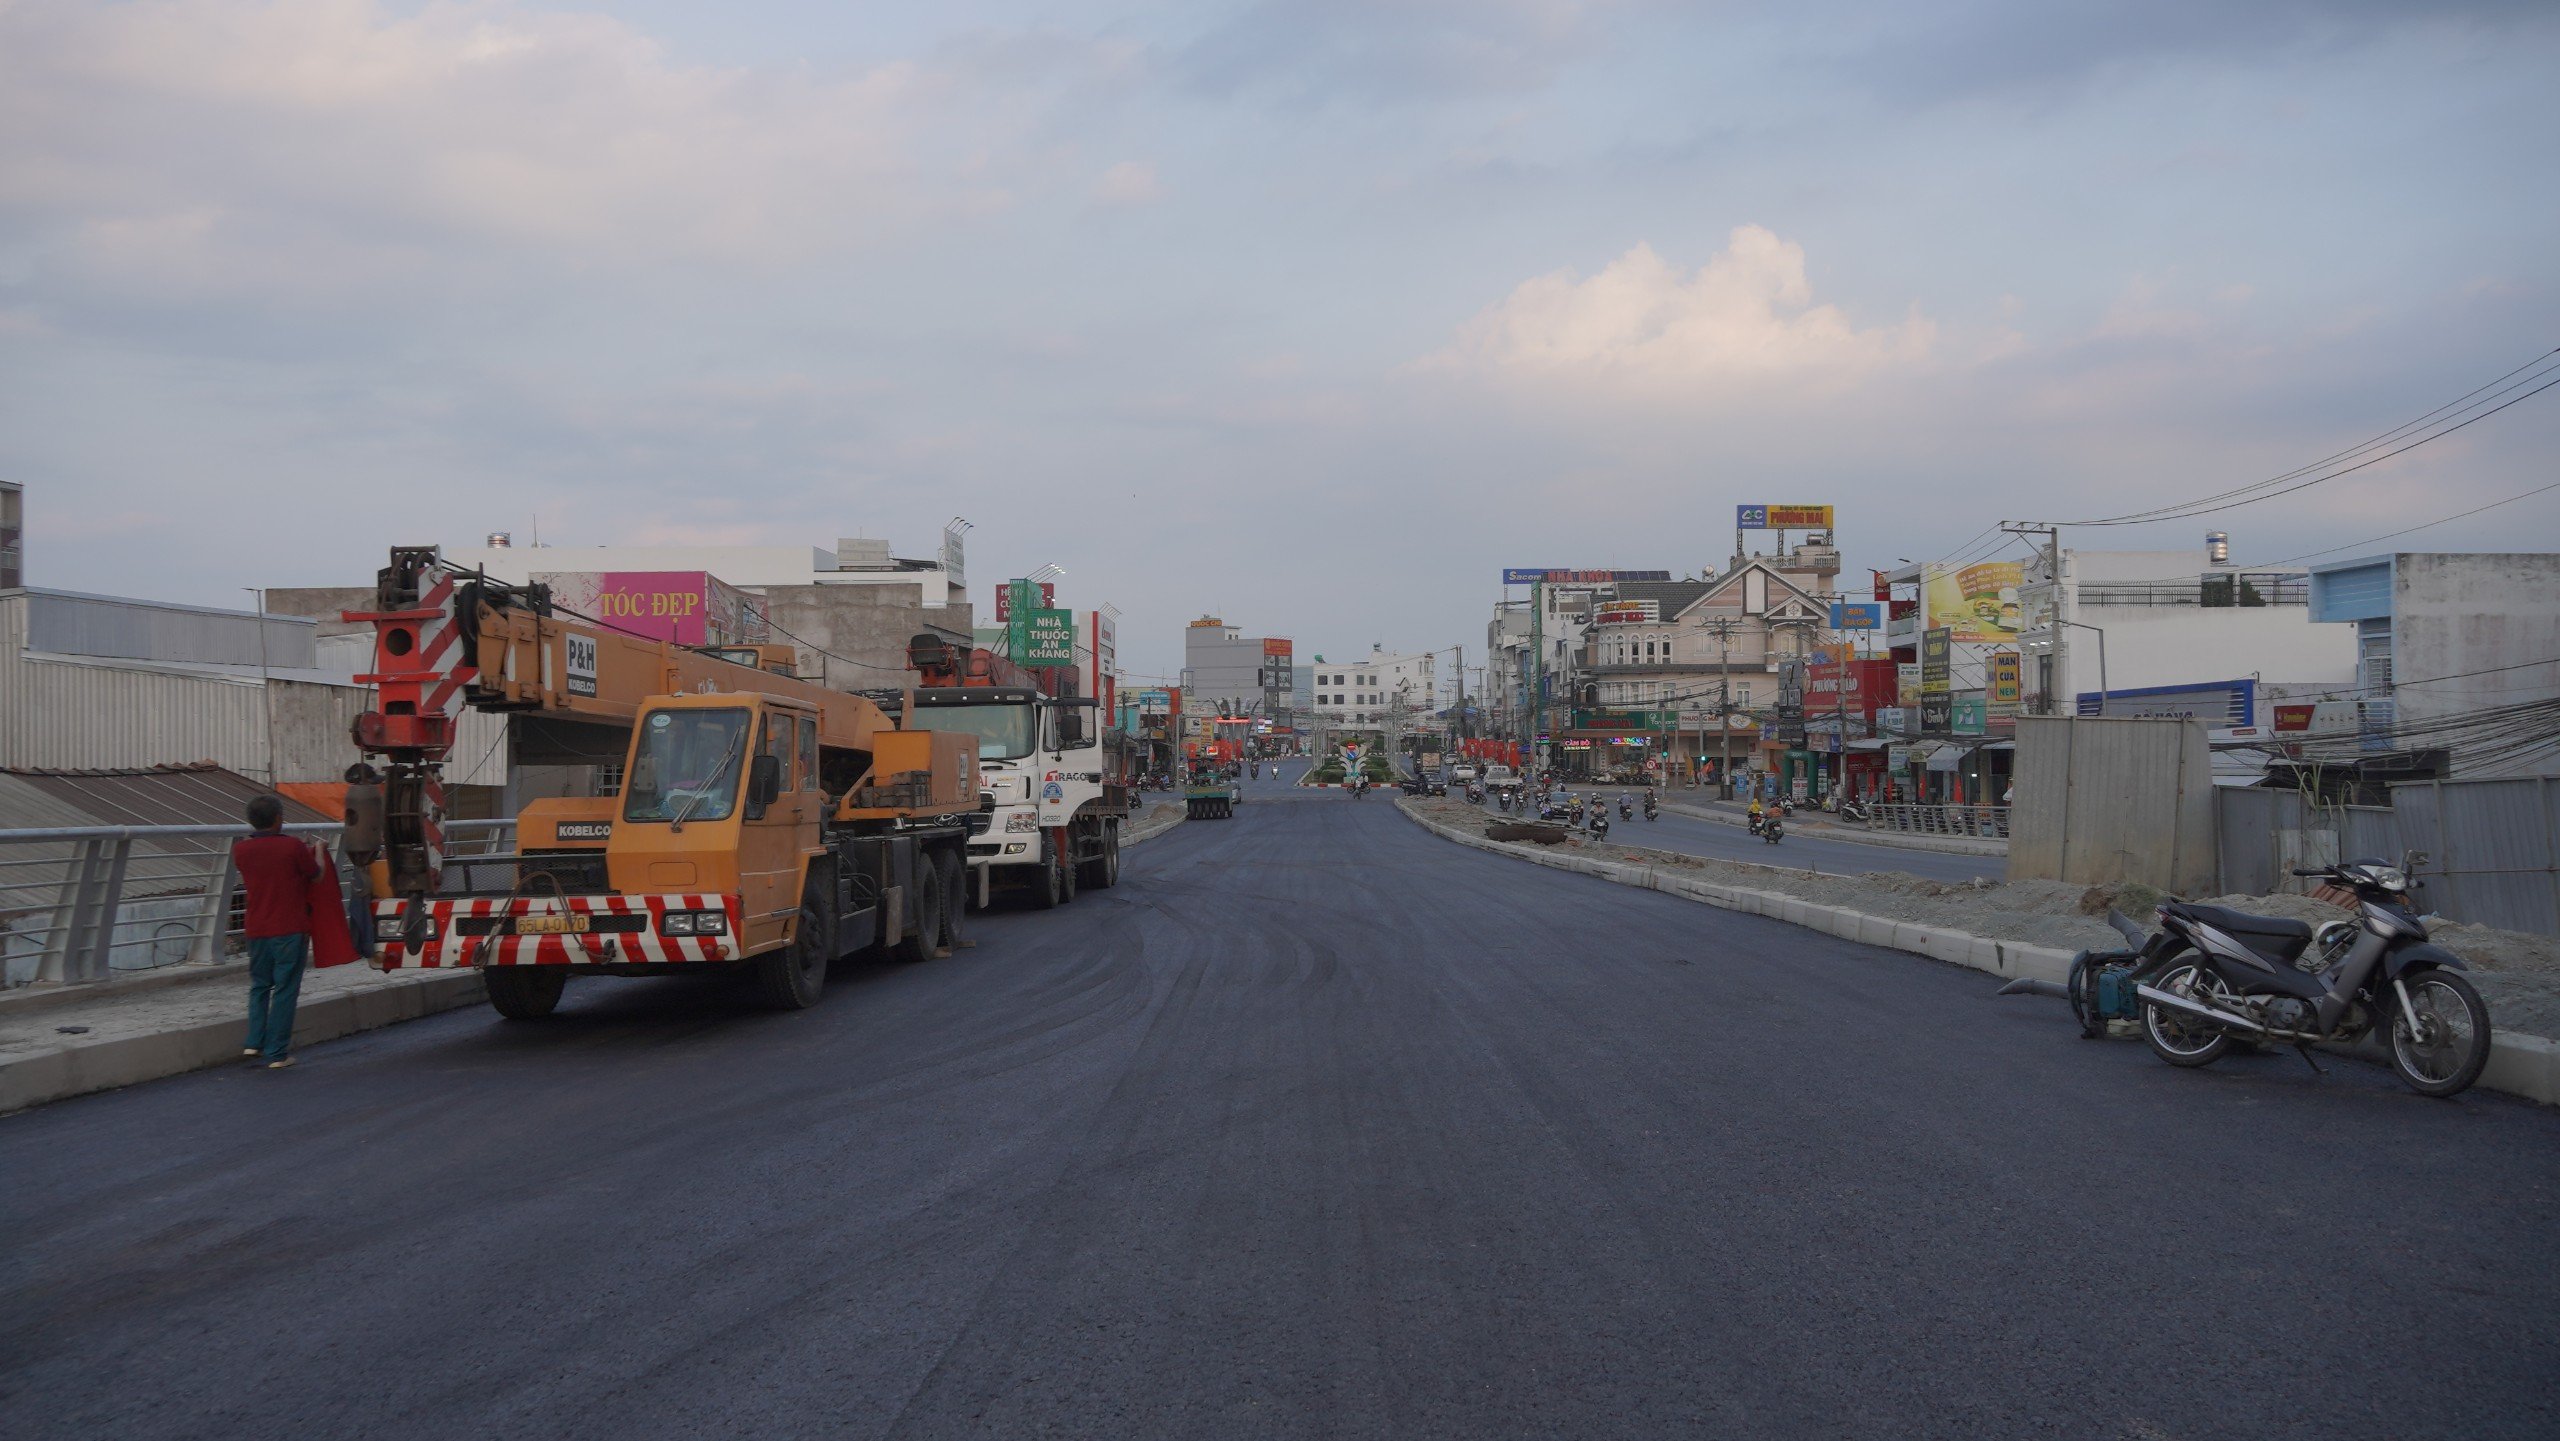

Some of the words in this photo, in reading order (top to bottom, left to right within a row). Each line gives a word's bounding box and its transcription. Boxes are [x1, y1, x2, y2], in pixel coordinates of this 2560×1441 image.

[601, 586, 645, 616] TÓC
[651, 592, 699, 624] ĐẸP
[1036, 616, 1062, 627] NHÀ
[1030, 628, 1070, 640] THUỐC
[1041, 640, 1059, 649] AN
[568, 639, 595, 671] P&H
[1029, 649, 1070, 659] KHANG
[2000, 672, 2015, 680] CUA
[568, 678, 596, 693] KOBELCO
[2000, 688, 2016, 696] NEM
[558, 825, 612, 837] KOBELCO
[517, 917, 587, 933] 65LA-0170
